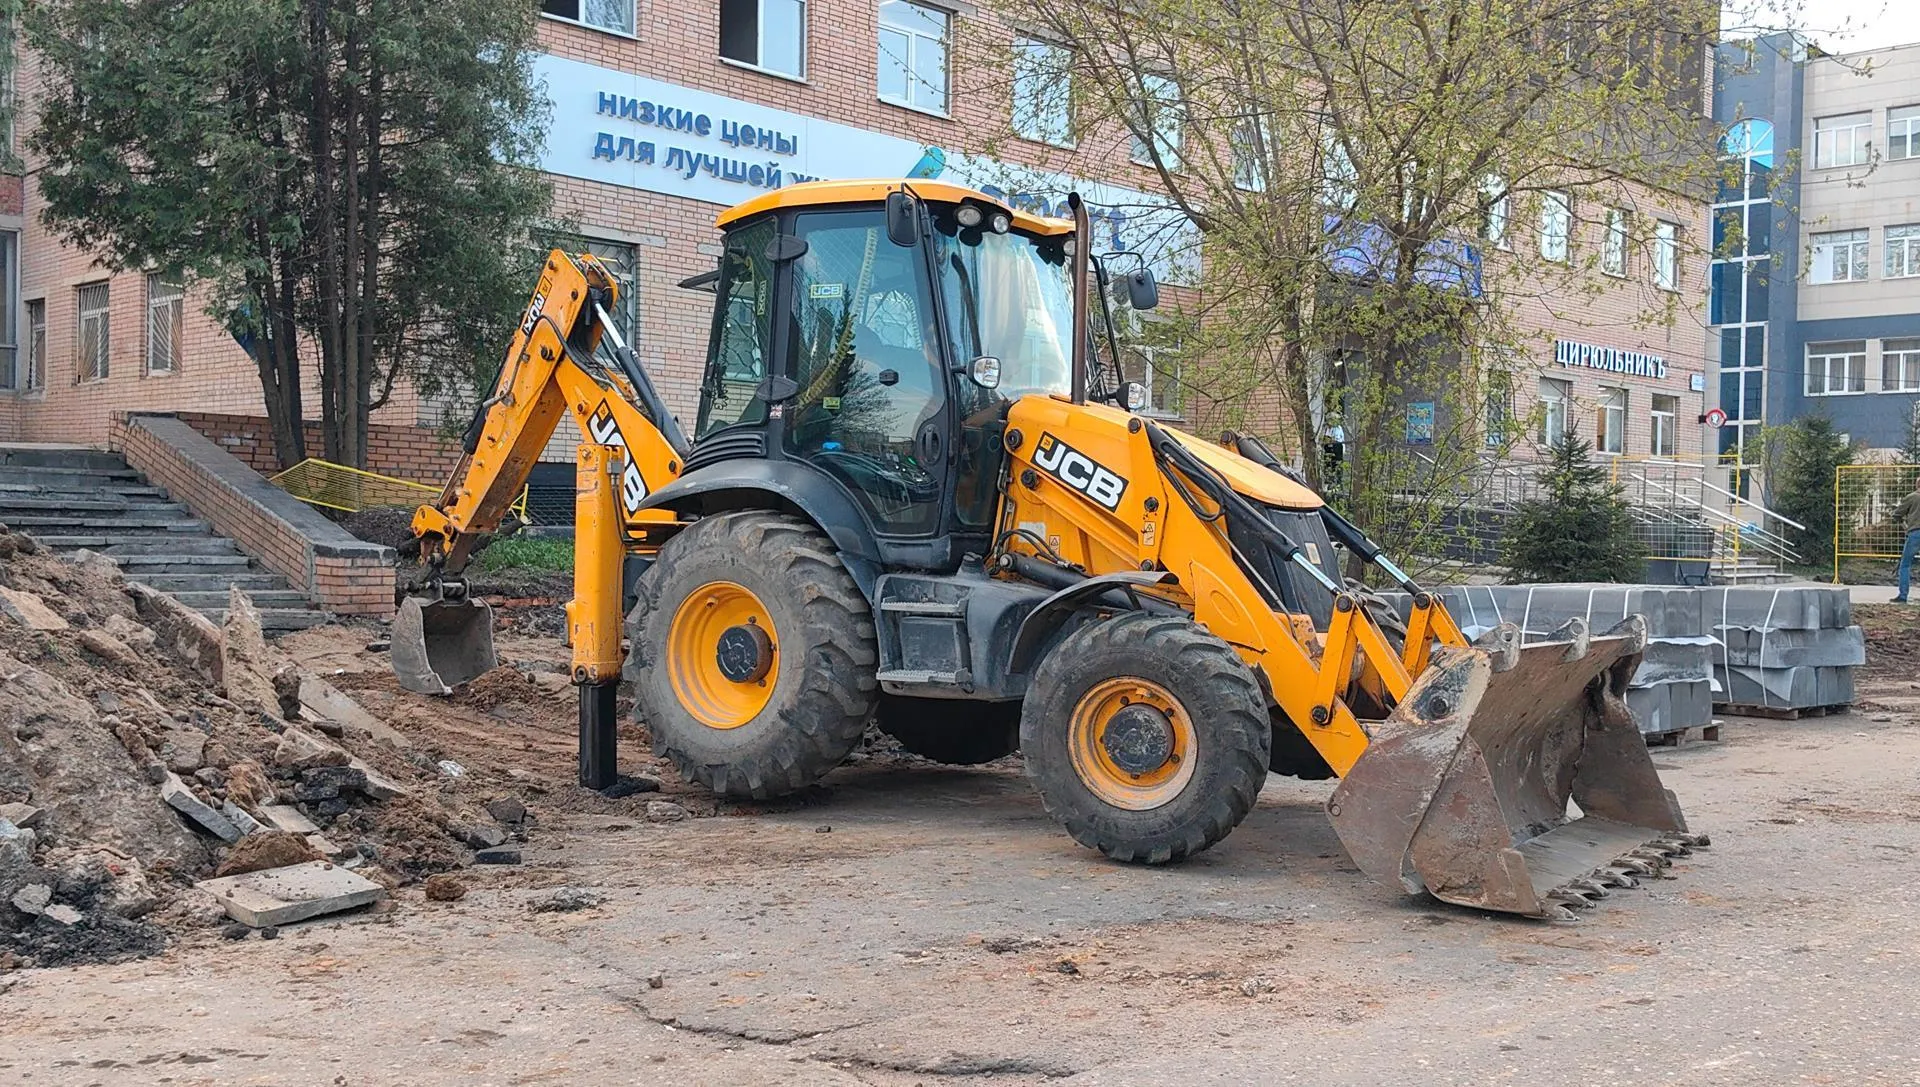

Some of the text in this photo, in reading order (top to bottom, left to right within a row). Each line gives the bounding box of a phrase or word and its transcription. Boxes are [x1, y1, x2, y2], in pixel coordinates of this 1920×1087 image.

[597, 91, 798, 156] низкие цены
[592, 131, 782, 190] для лучшей
[813, 286, 840, 296] JCB
[1556, 339, 1667, 379] ЦИРЮЛЬНИКЪ
[1035, 443, 1124, 508] JCB
